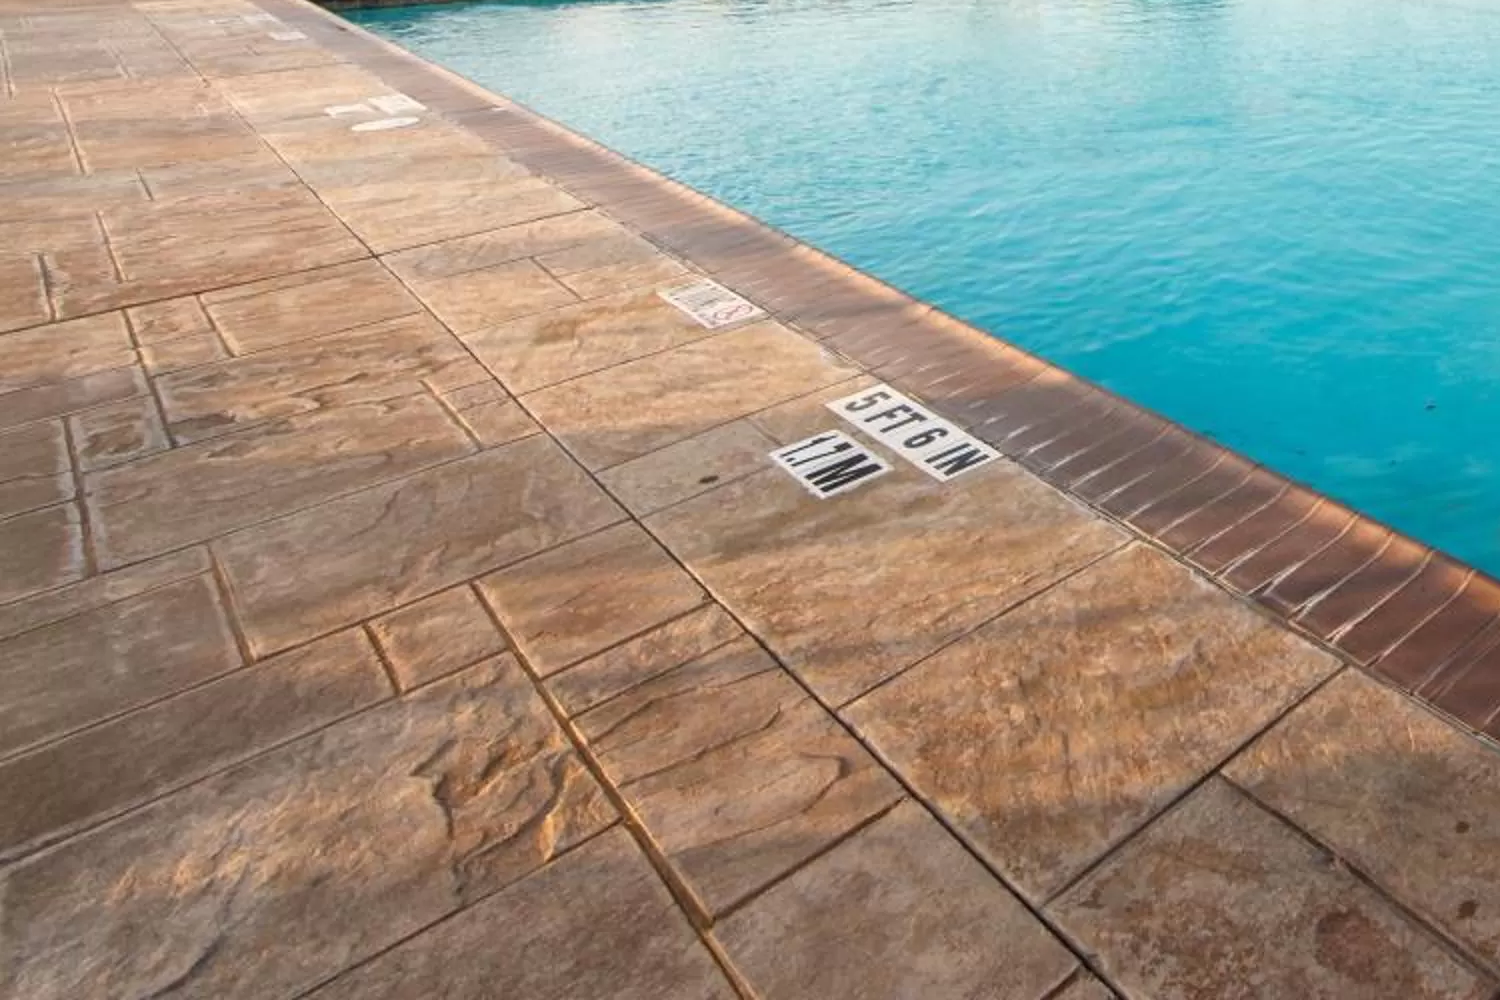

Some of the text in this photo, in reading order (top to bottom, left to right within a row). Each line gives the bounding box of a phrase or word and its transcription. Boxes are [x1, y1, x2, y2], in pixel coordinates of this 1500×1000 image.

[780, 434, 883, 493] 1.7 M
[845, 391, 991, 477] 5 FT 6 IN
